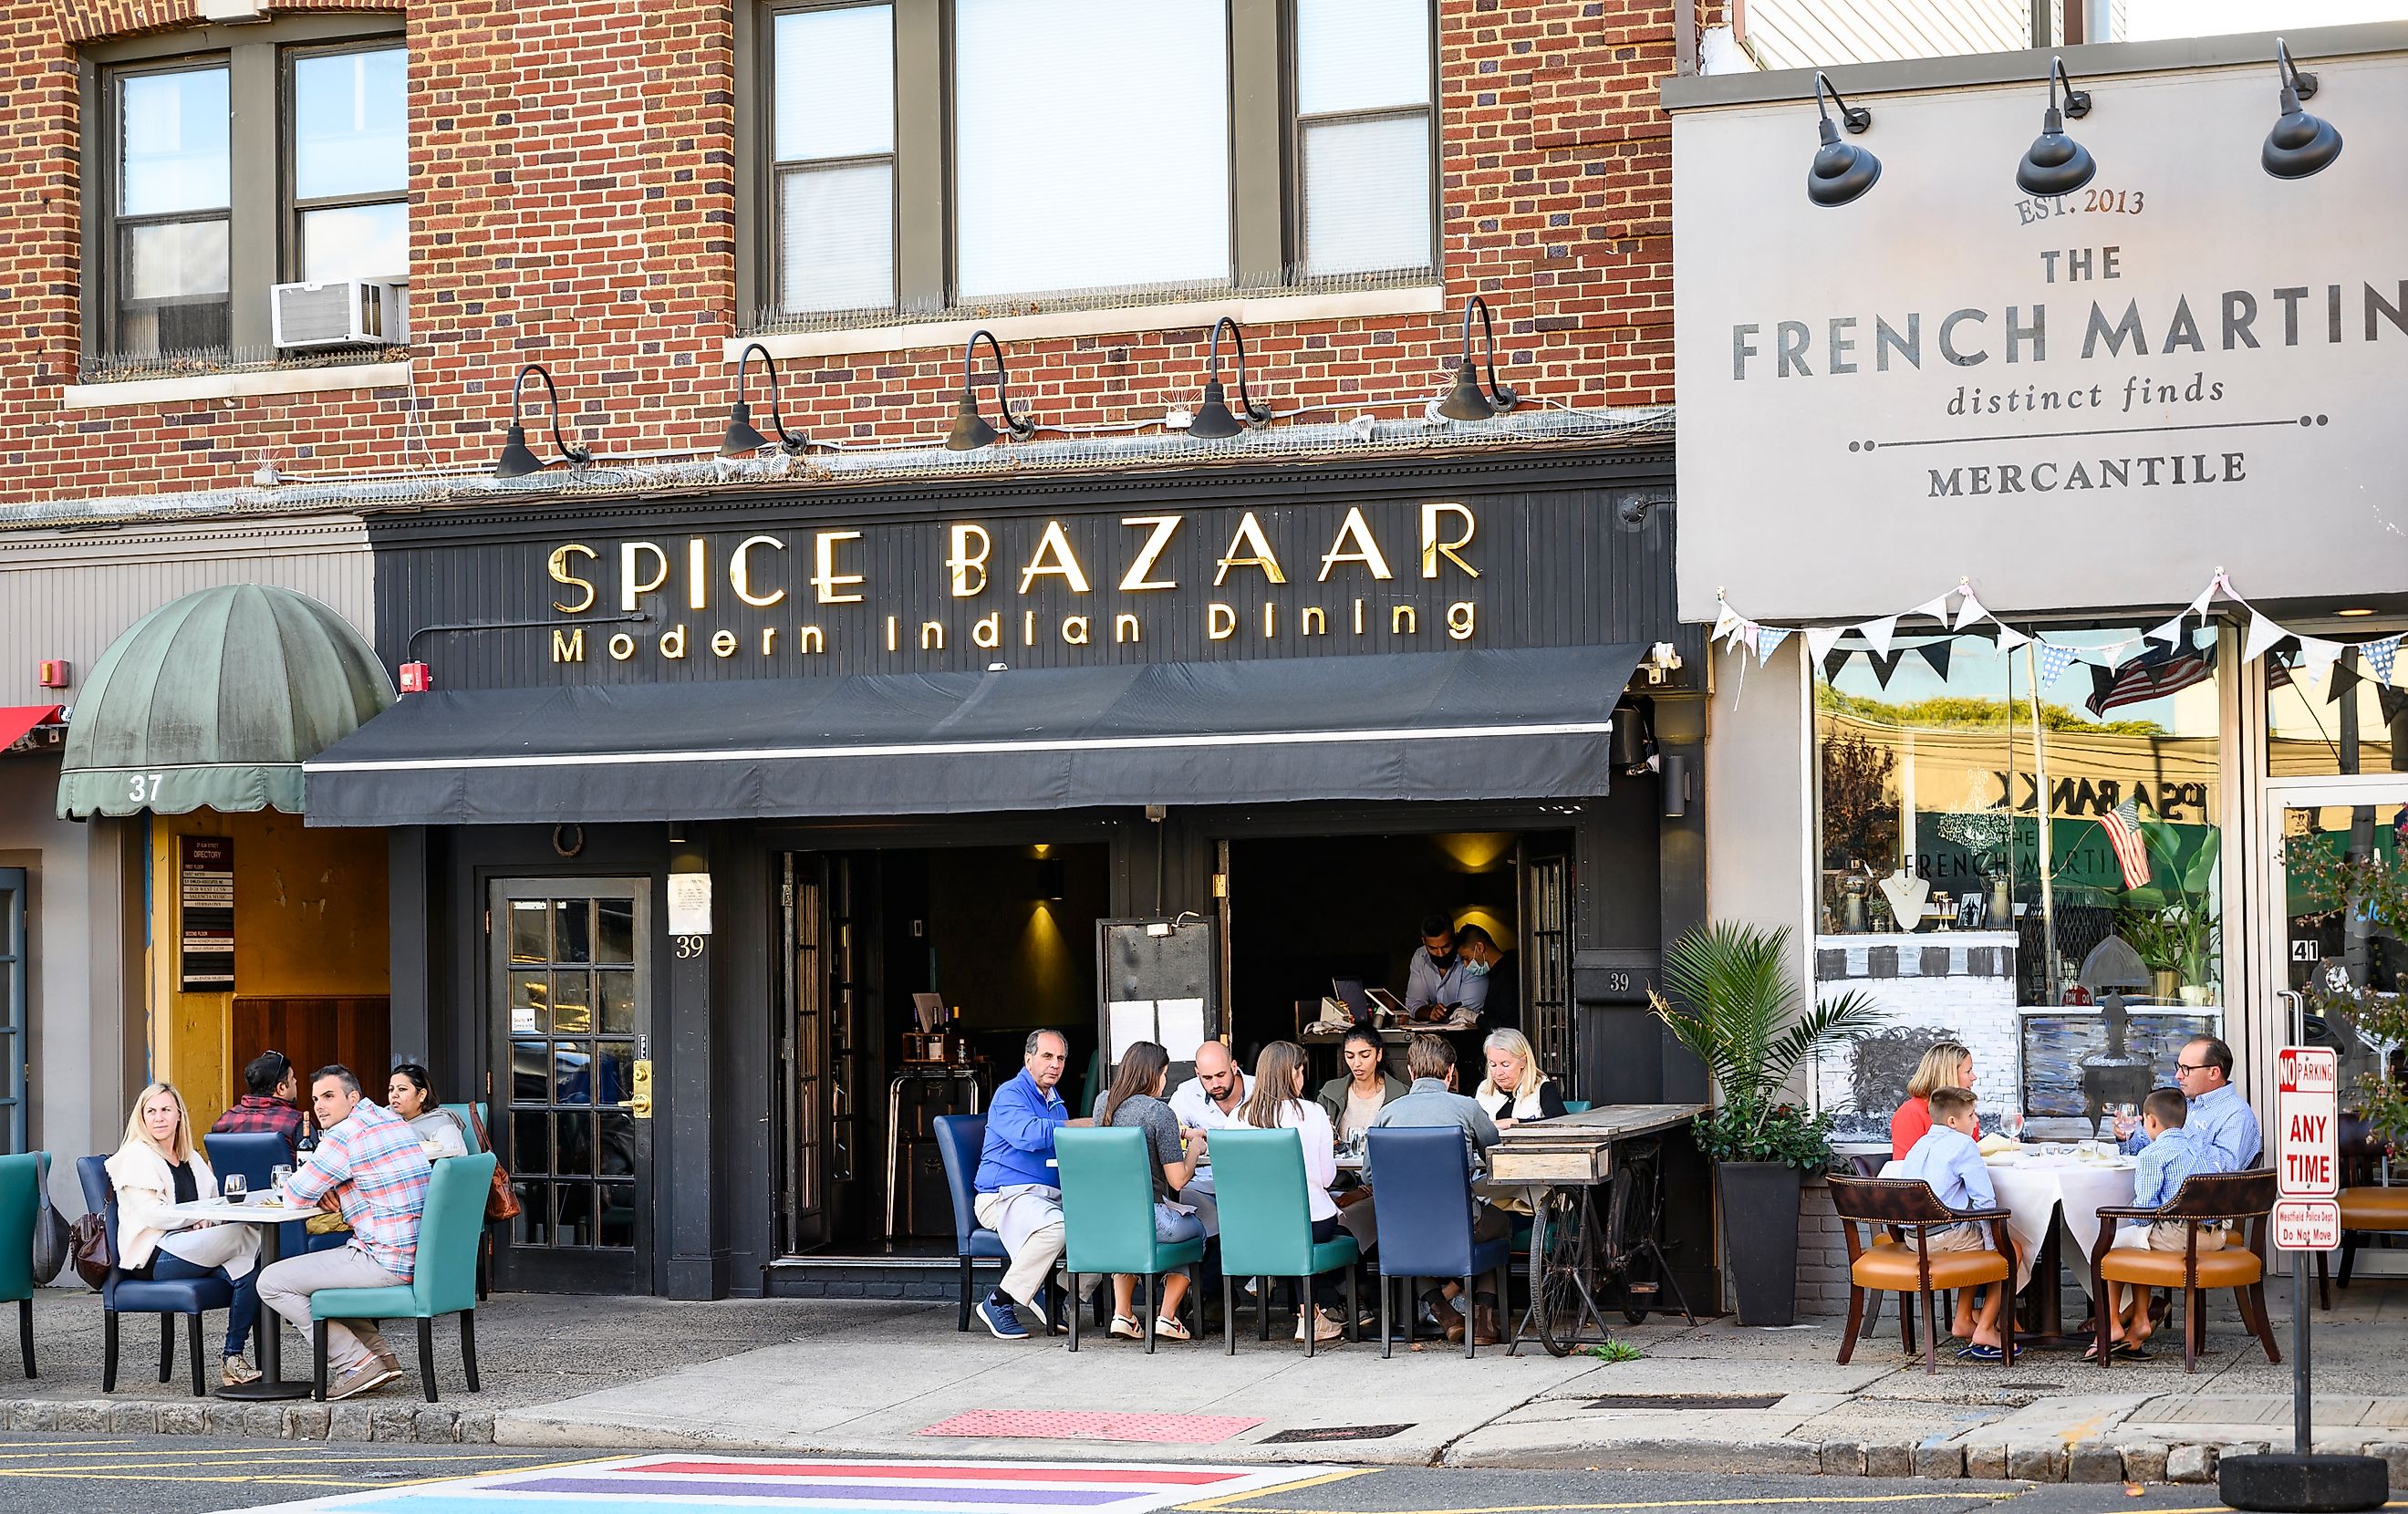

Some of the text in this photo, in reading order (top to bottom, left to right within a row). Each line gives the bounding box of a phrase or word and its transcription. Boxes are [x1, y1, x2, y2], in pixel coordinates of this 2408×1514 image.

[2015, 189, 2144, 225] EST. 2013
[2040, 245, 2121, 284] THE
[1732, 304, 2046, 381] FRENCH
[1946, 371, 2225, 417] distinct finds
[1927, 451, 2247, 498] MERCANTILE
[547, 503, 1482, 614] SPICE BAZAAR
[552, 624, 825, 663] Modern
[887, 611, 1140, 652] Indian
[129, 773, 162, 803] 37
[193, 850, 222, 858] DIRECTORY
[1904, 852, 2008, 879] FRENCH
[676, 935, 704, 959] 39
[2294, 941, 2318, 960] 41
[1610, 972, 1629, 991] 39
[2280, 1057, 2332, 1086] NO PARKING
[2289, 1115, 2327, 1144] ANY
[2287, 1154, 2330, 1183] TIME
[2280, 1210, 2334, 1224] Westfield Police Dept.
[2283, 1229, 2331, 1240] Do Not Move
